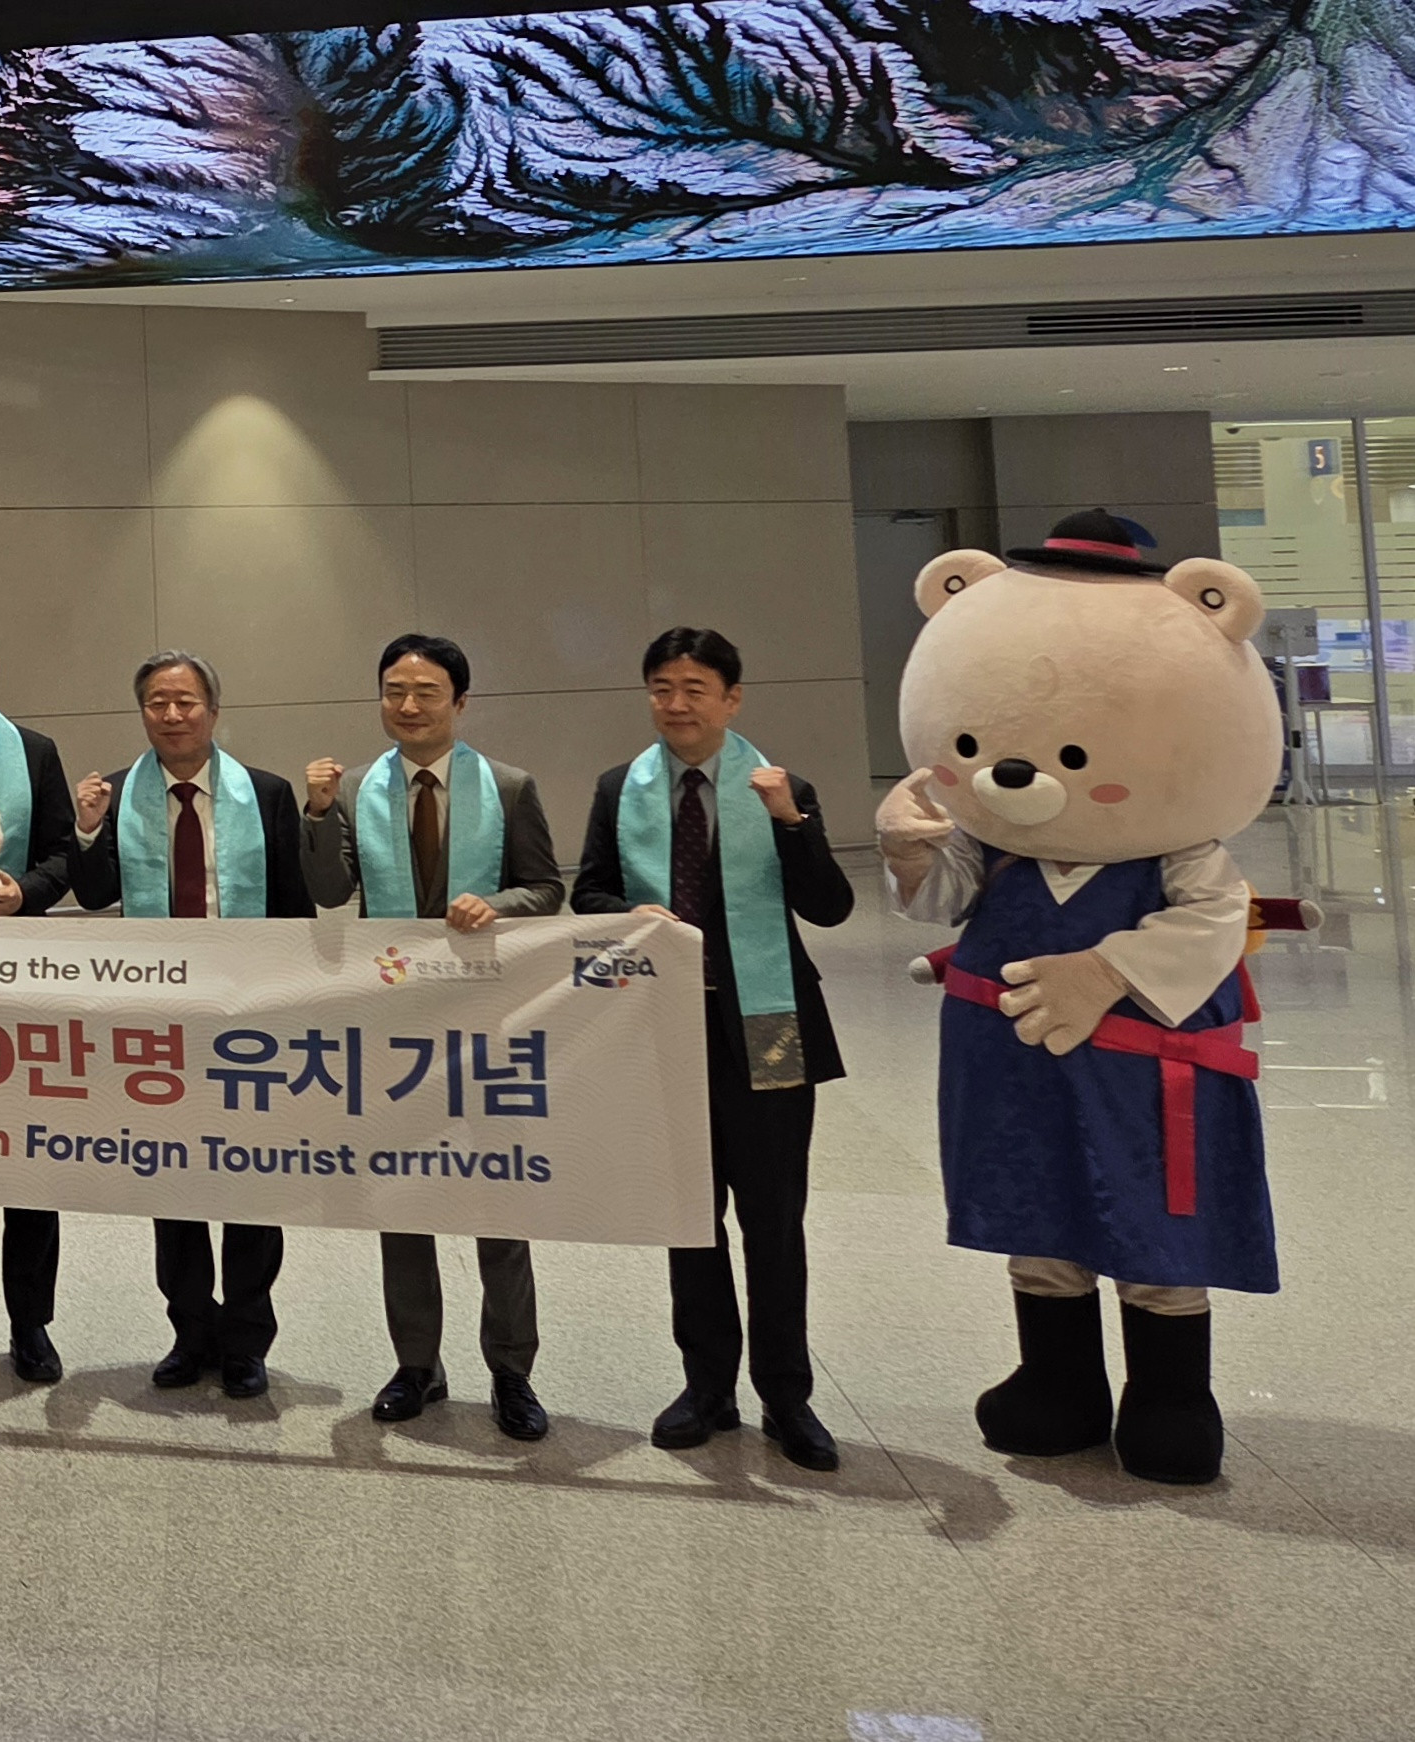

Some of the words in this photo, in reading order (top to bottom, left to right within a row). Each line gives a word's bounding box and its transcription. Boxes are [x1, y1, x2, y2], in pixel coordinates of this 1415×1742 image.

[28, 956, 81, 981] the
[90, 958, 188, 986] World
[573, 955, 658, 988] Korea
[112, 1022, 186, 1106] 명
[206, 1026, 363, 1117] 유치
[386, 1028, 549, 1119] 기념
[26, 1125, 187, 1177] Foreign
[201, 1136, 356, 1176] Tourist
[369, 1140, 552, 1183] arrivals
